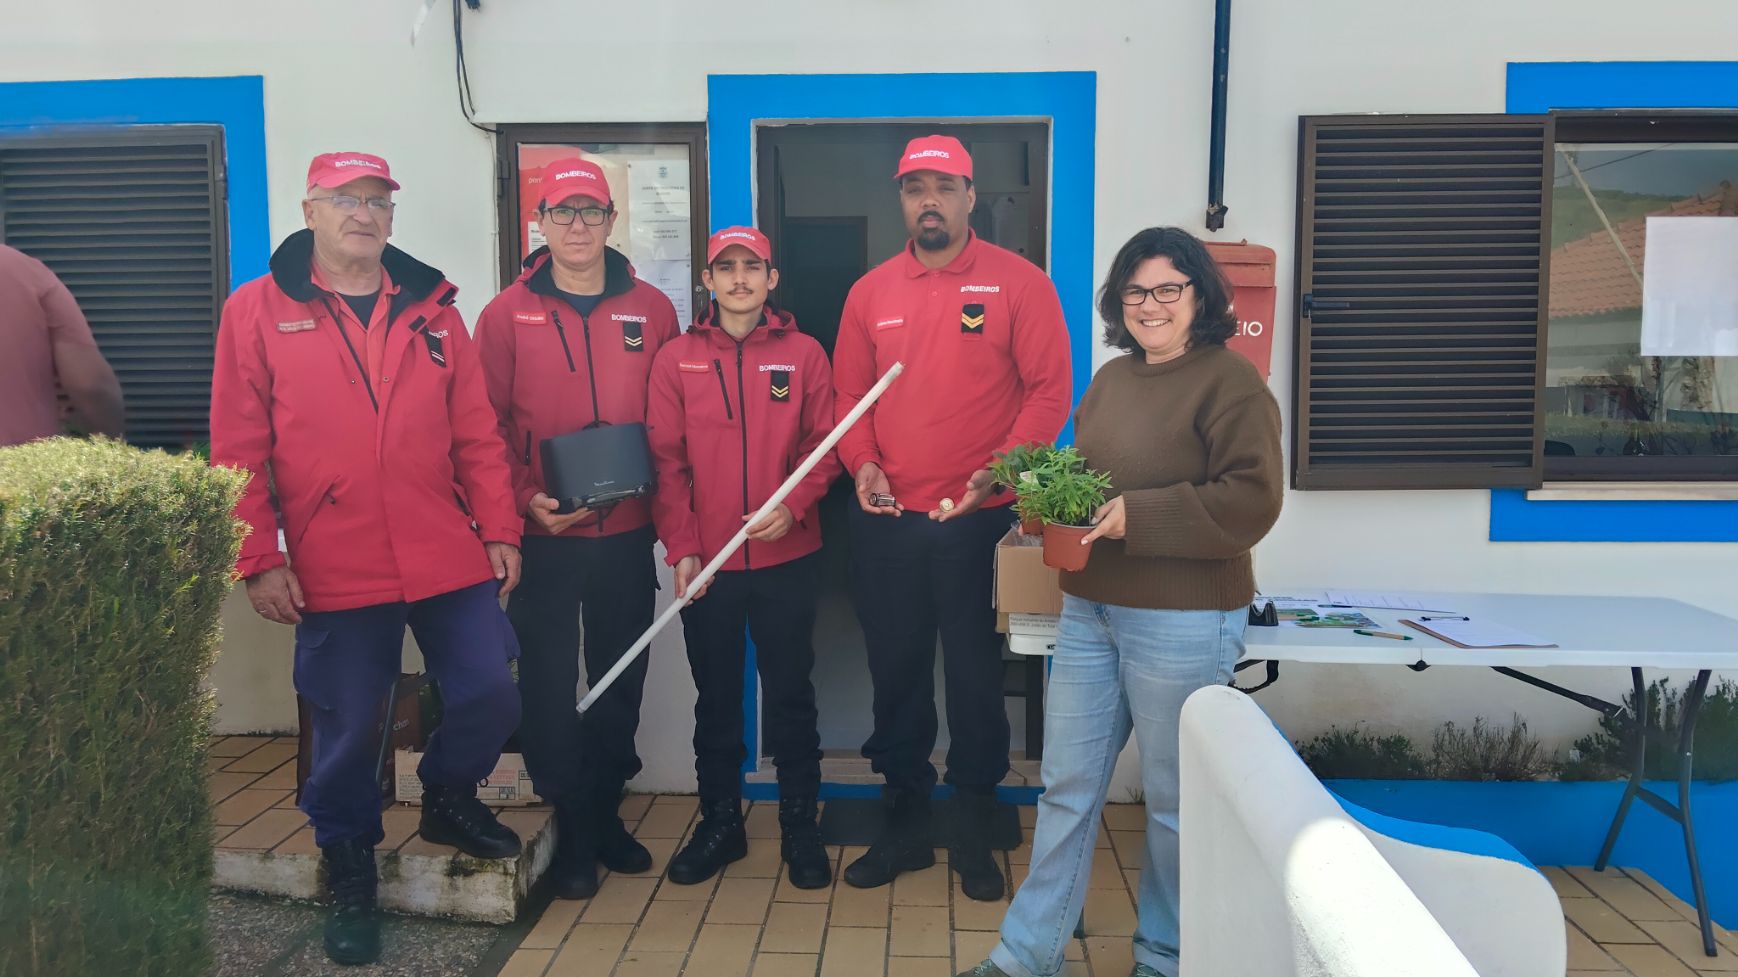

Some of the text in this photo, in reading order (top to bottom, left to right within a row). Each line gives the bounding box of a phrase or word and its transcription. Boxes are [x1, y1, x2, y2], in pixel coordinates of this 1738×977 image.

[909, 150, 950, 159] BOMBEIROS
[335, 159, 382, 168] BOMBEI
[555, 170, 597, 180] BOMBEIROS
[960, 284, 1000, 293] BOMBEIROS
[611, 313, 647, 323] BOMBEIROS
[759, 364, 796, 372] BOMBEIROS
